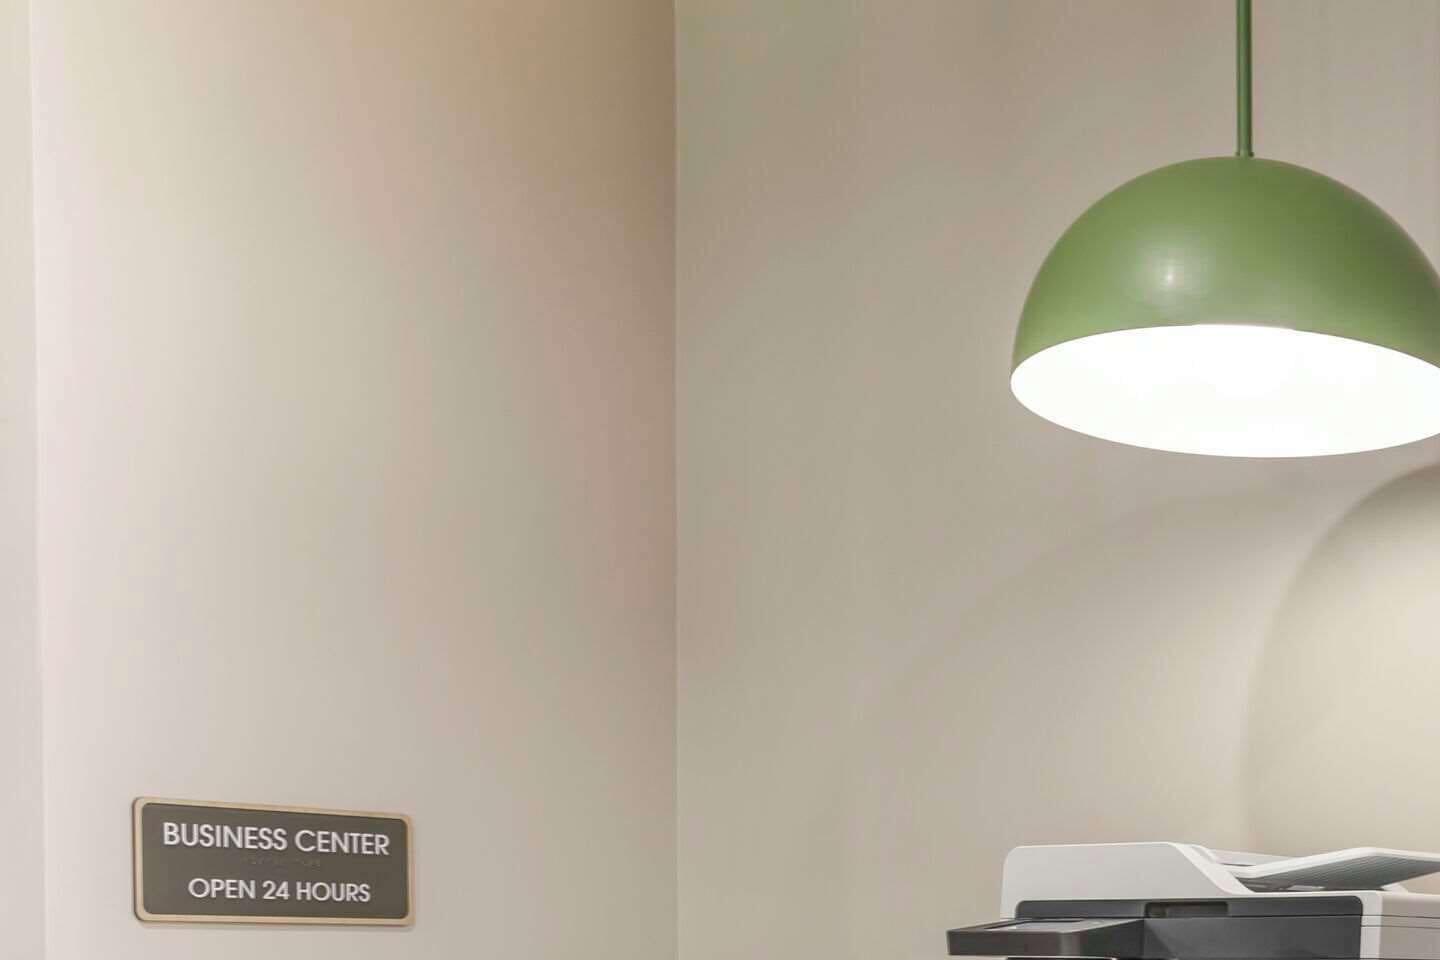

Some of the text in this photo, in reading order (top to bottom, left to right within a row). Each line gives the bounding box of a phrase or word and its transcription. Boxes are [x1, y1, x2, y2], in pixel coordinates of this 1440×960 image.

[162, 821, 391, 856] BUSINESS CENTER
[187, 877, 371, 903] OPEN 24 HOURS
